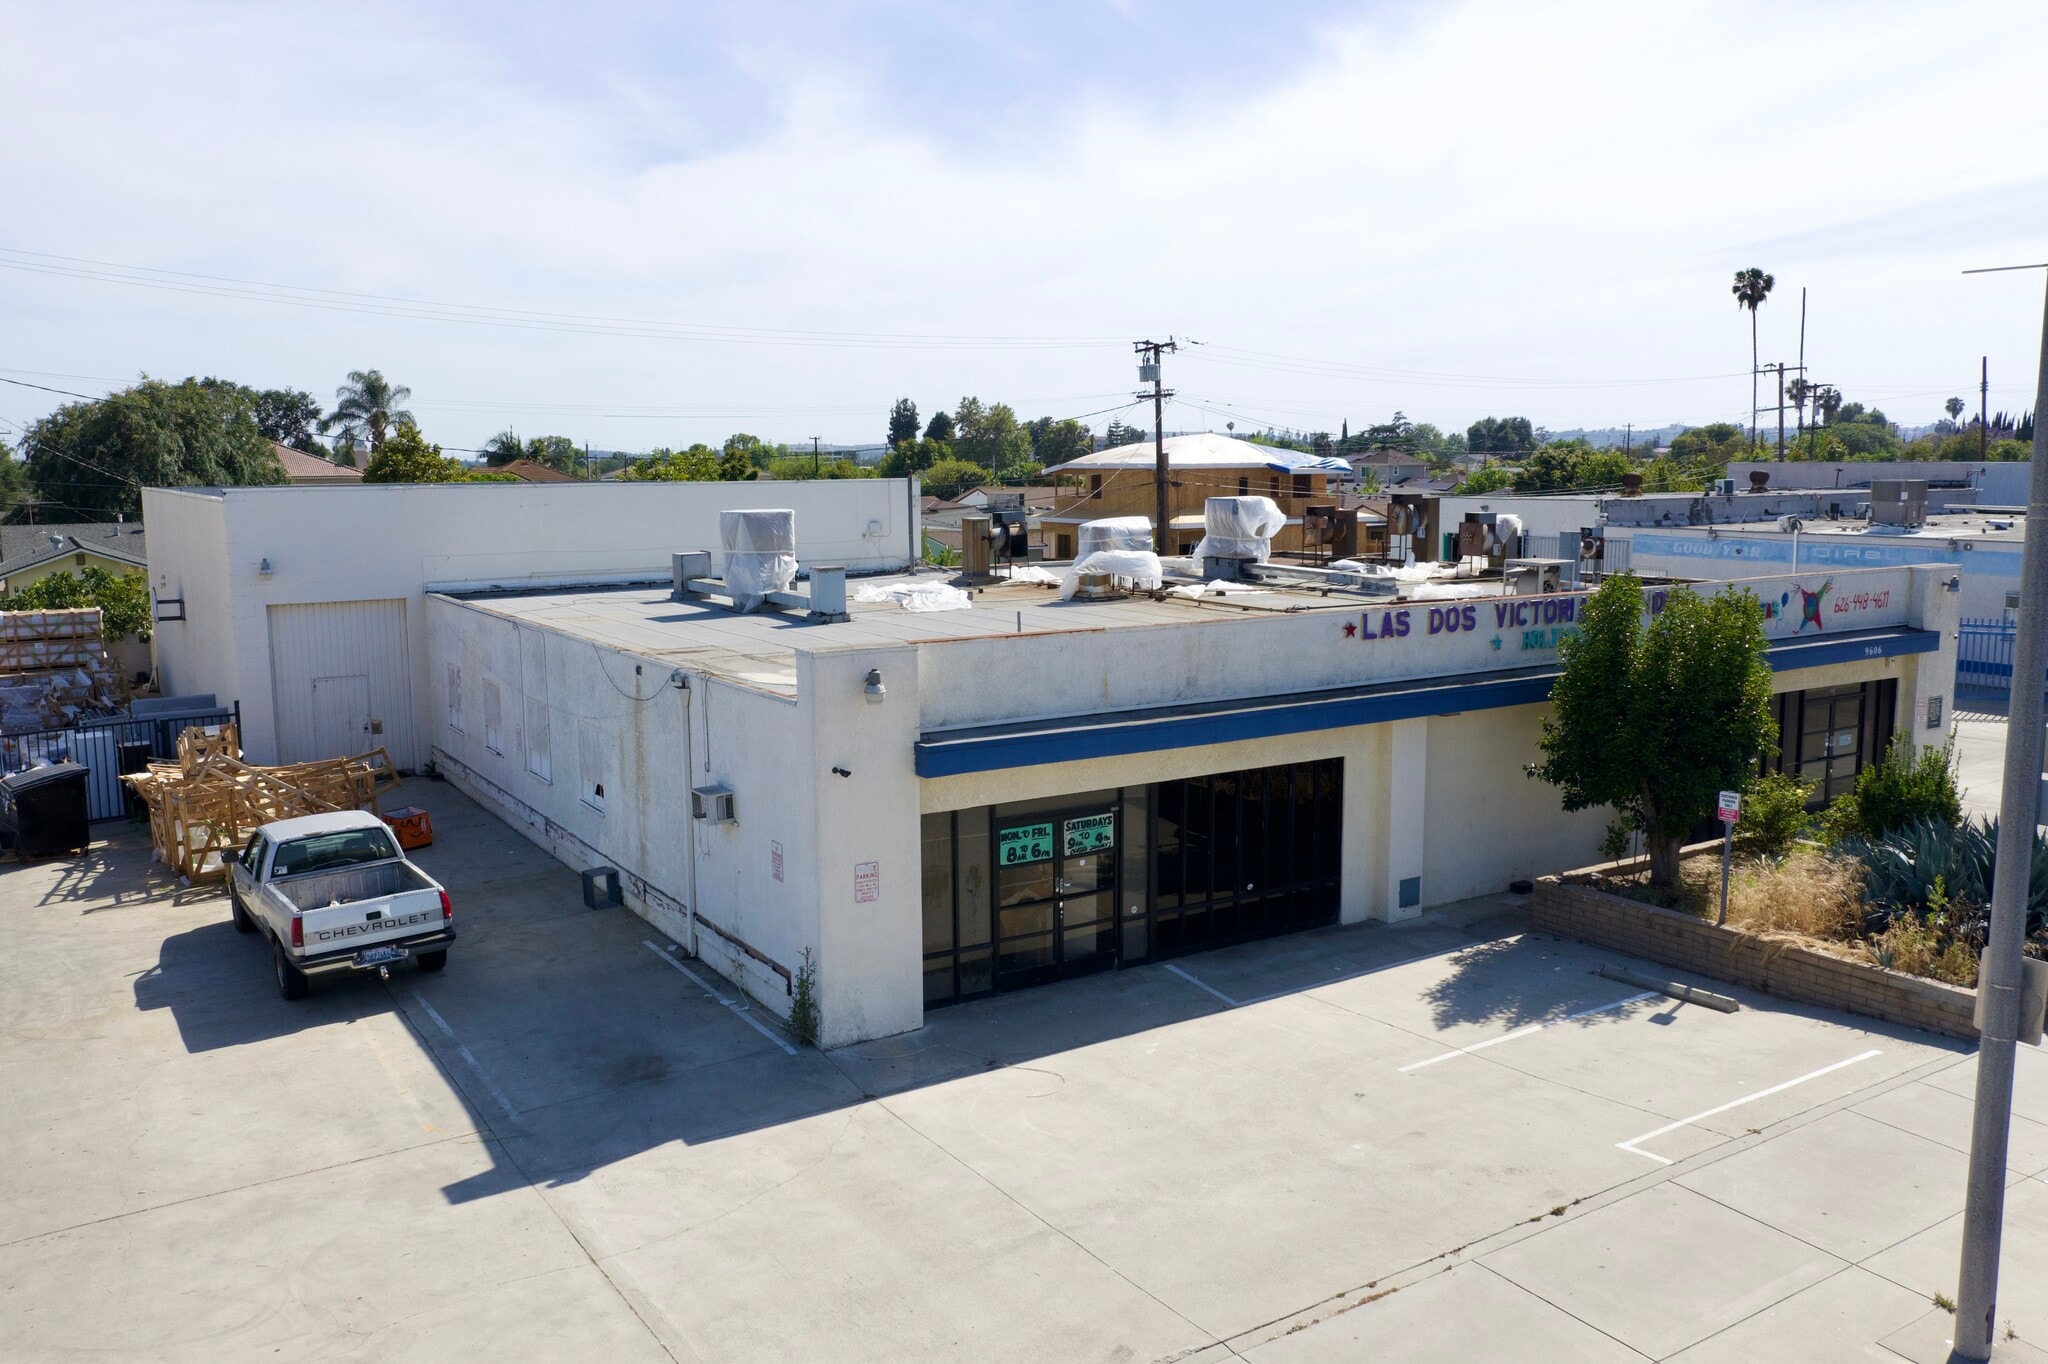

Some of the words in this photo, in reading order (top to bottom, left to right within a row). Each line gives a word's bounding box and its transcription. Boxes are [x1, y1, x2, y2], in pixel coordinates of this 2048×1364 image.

[1673, 542, 1714, 555] GOOD
[1834, 590, 1889, 613] 626-448-4611
[1362, 609, 1411, 639] LAS
[1427, 604, 1477, 635] DOS
[1864, 645, 1882, 656] 9606
[1065, 815, 1112, 832] SATURDAYS
[1021, 830, 1030, 838] TO
[1032, 827, 1049, 838] FRI.
[1068, 837, 1076, 849] 9
[1079, 832, 1090, 840] TO
[1095, 832, 1103, 843] 4
[1007, 847, 1017, 862] 8
[1031, 843, 1041, 858] 6
[319, 912, 429, 940] CHEVROLET
